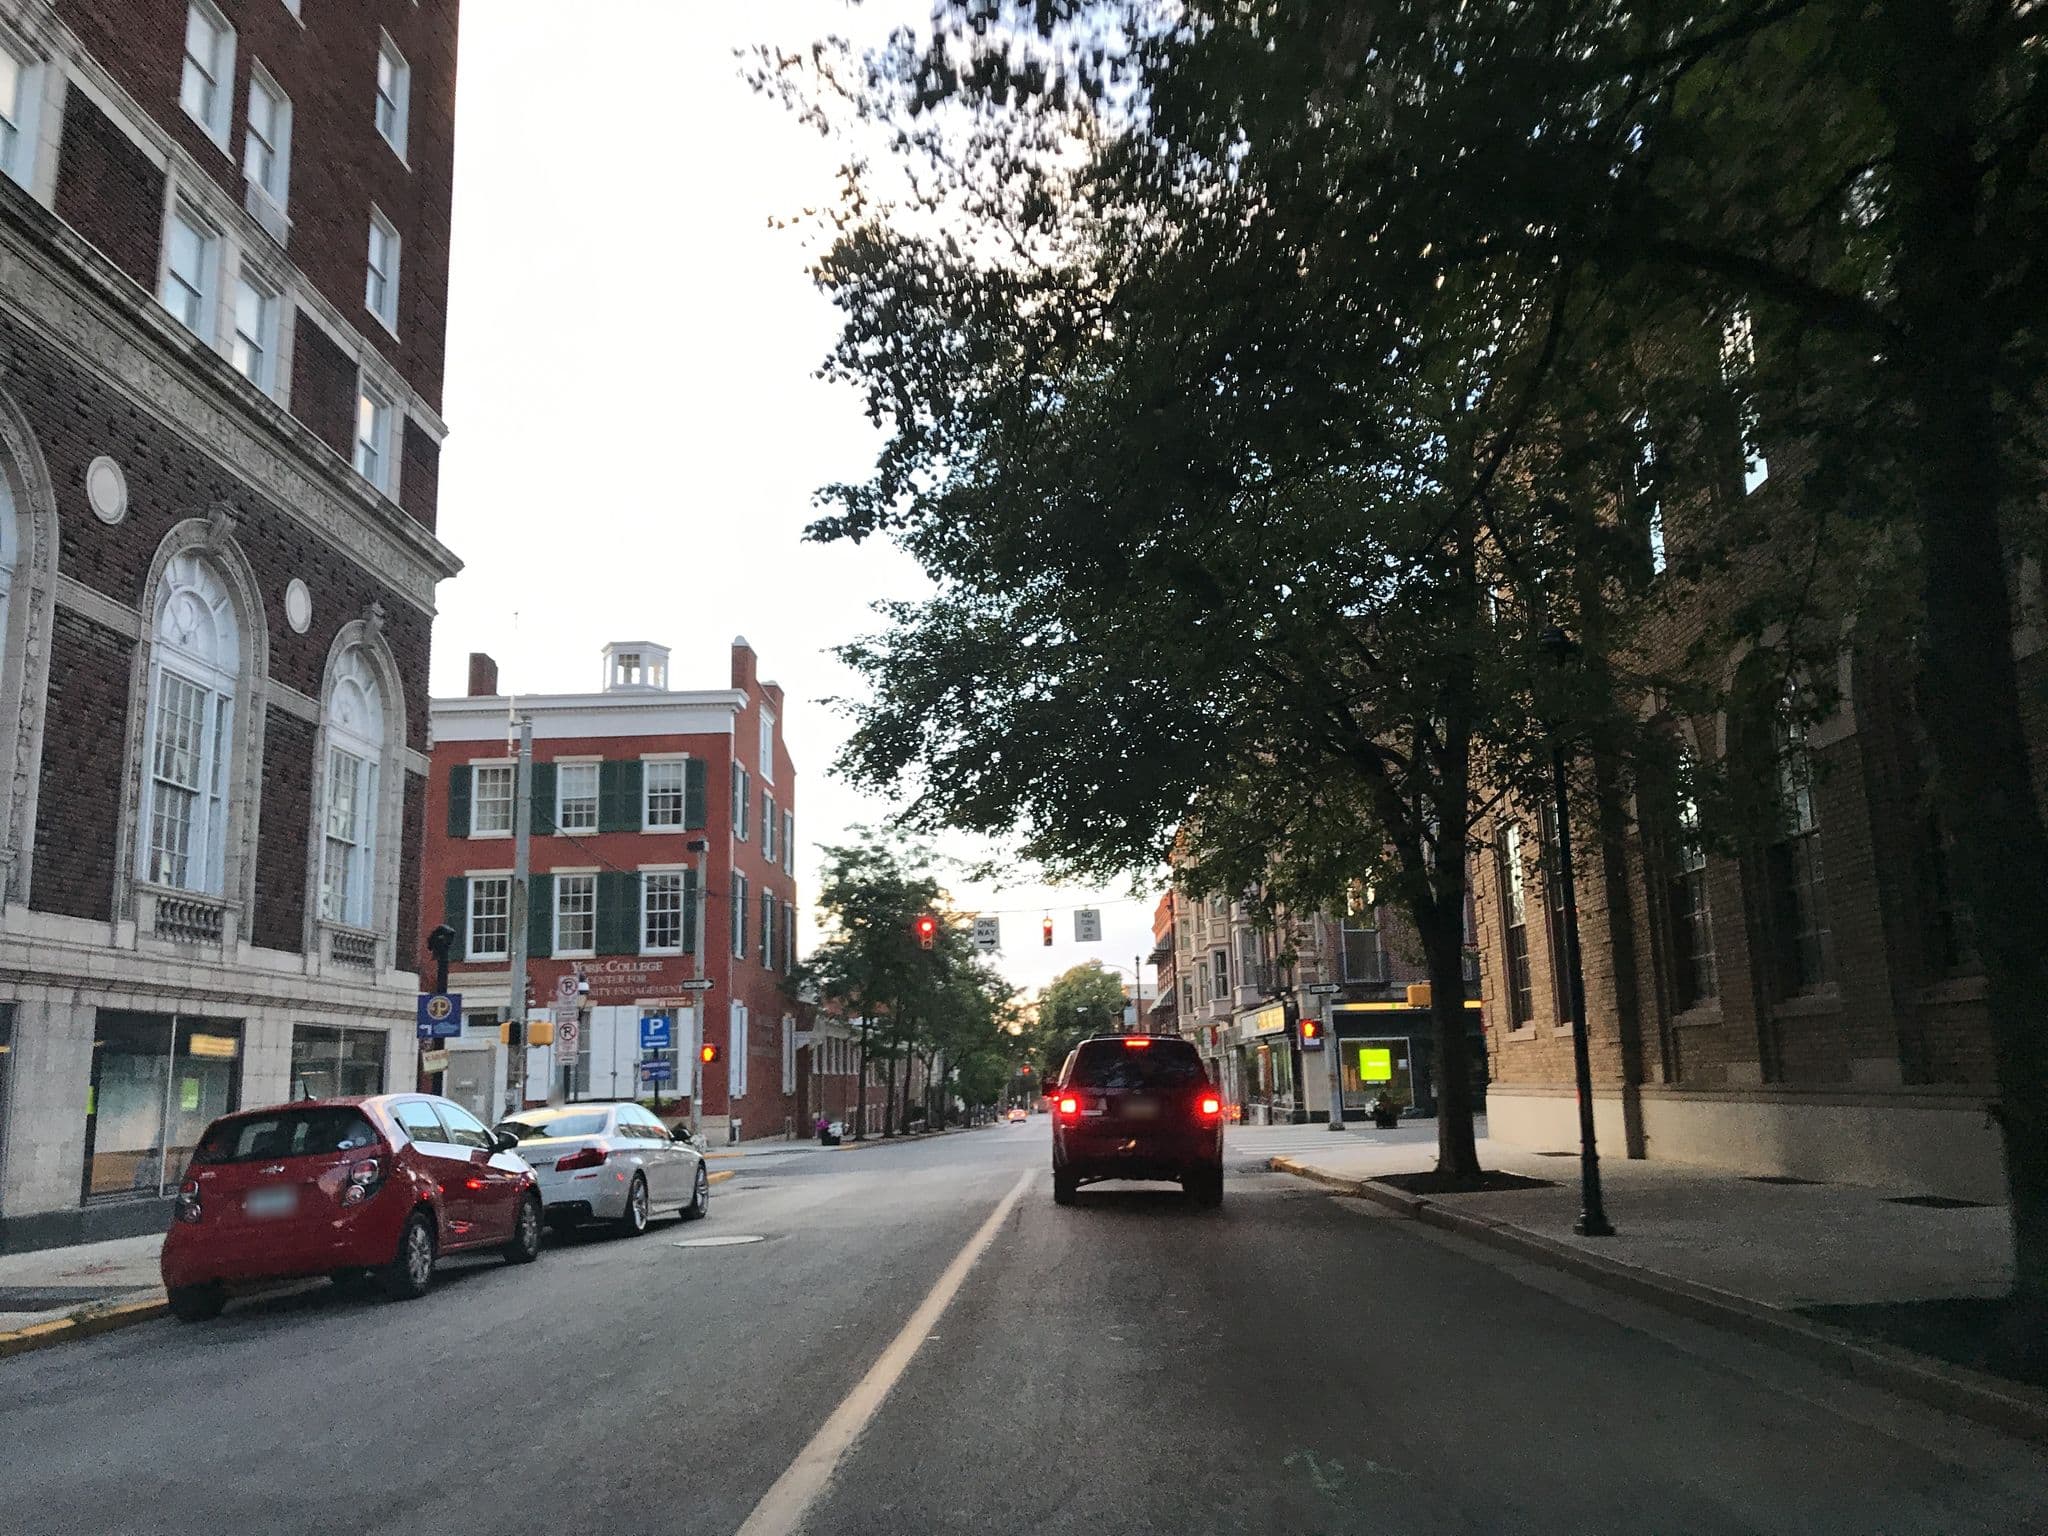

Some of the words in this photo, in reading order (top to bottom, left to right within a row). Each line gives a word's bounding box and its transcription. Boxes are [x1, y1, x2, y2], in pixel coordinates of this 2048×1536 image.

[977, 920, 996, 928] ONE
[977, 929, 996, 937] WAY
[605, 961, 662, 973] COLLEGE
[649, 1018, 664, 1035] P
